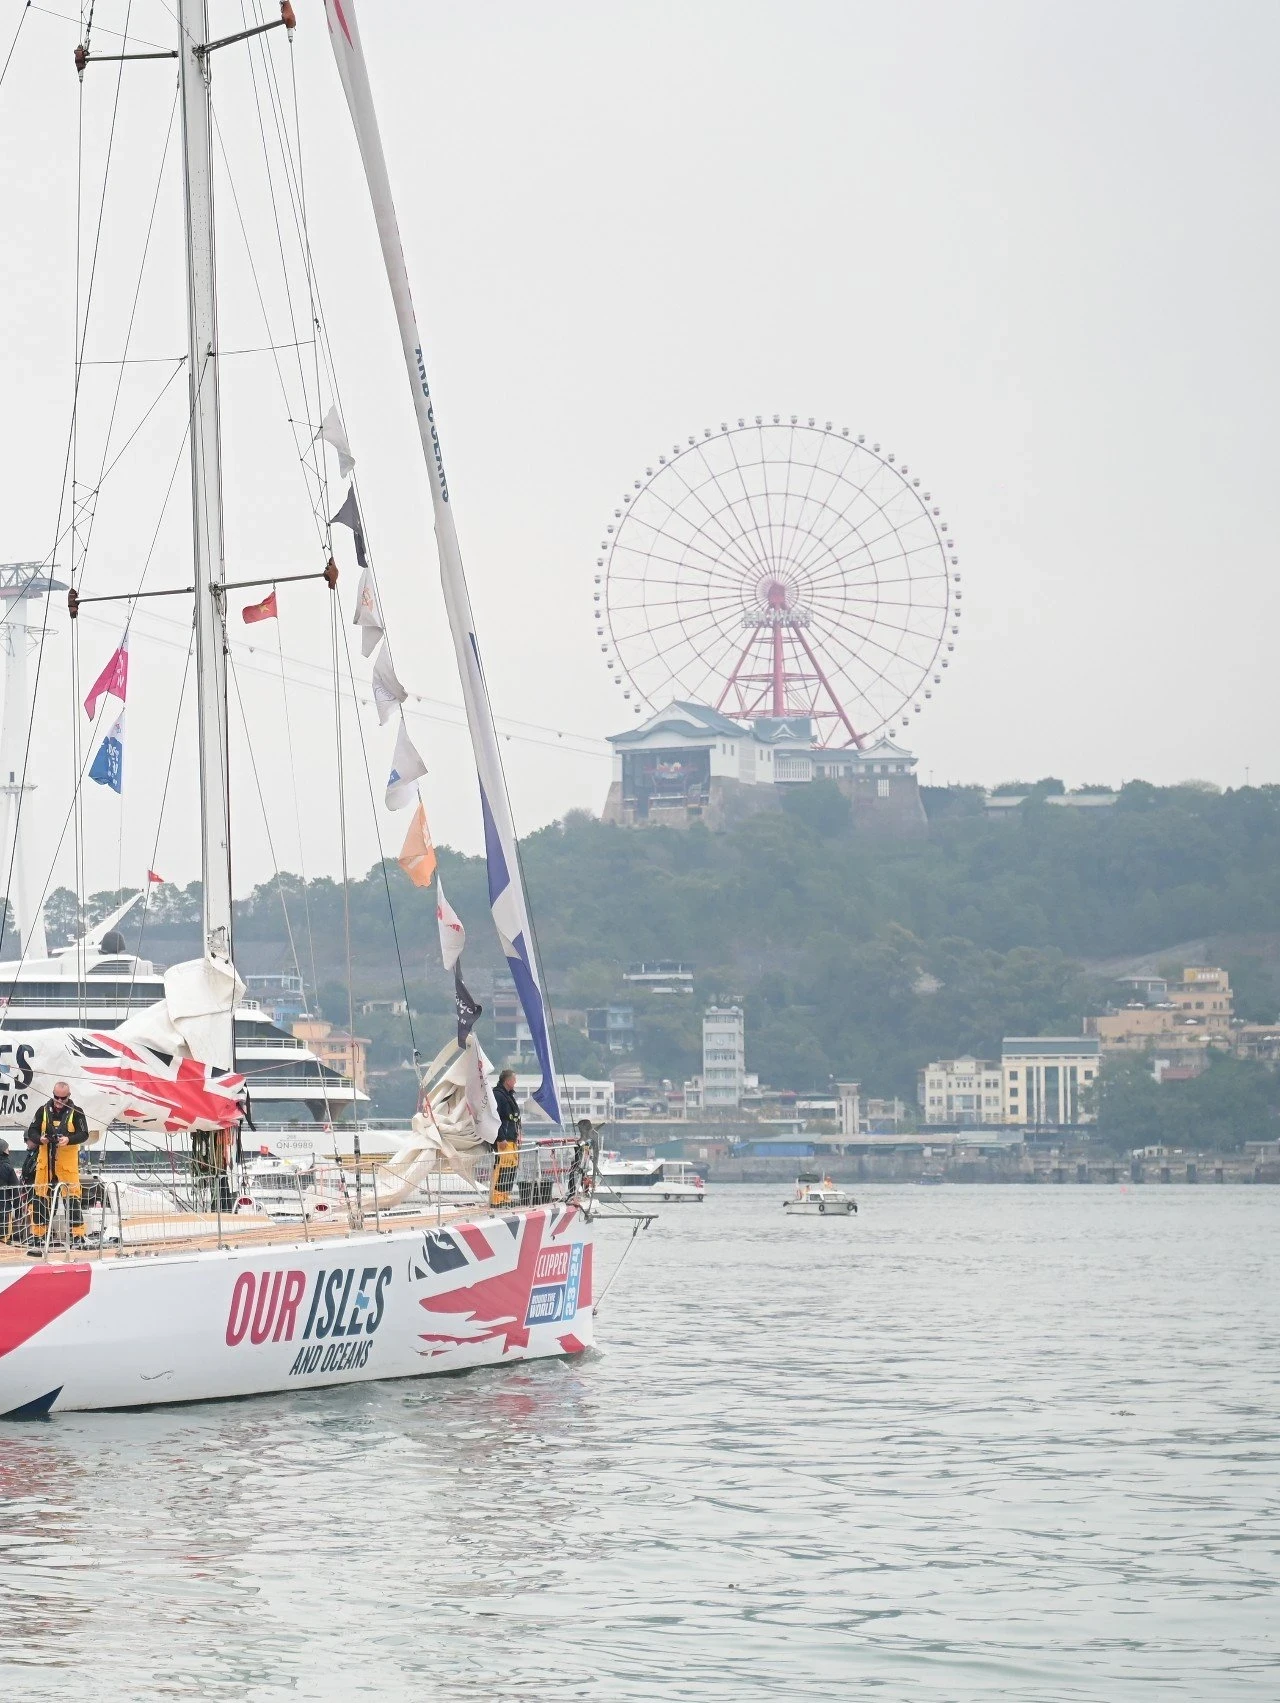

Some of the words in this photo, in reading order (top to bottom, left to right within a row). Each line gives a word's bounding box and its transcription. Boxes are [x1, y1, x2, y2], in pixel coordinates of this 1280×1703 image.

[276, 1141, 313, 1149] QN-9989
[536, 1252, 569, 1278] CLIPPER
[565, 1247, 581, 1317] 23-24
[225, 1270, 306, 1347] OUR
[302, 1265, 393, 1340] ISLES
[529, 1302, 555, 1318] WORLD
[288, 1344, 319, 1376] AND
[320, 1339, 374, 1372] OCEANS
